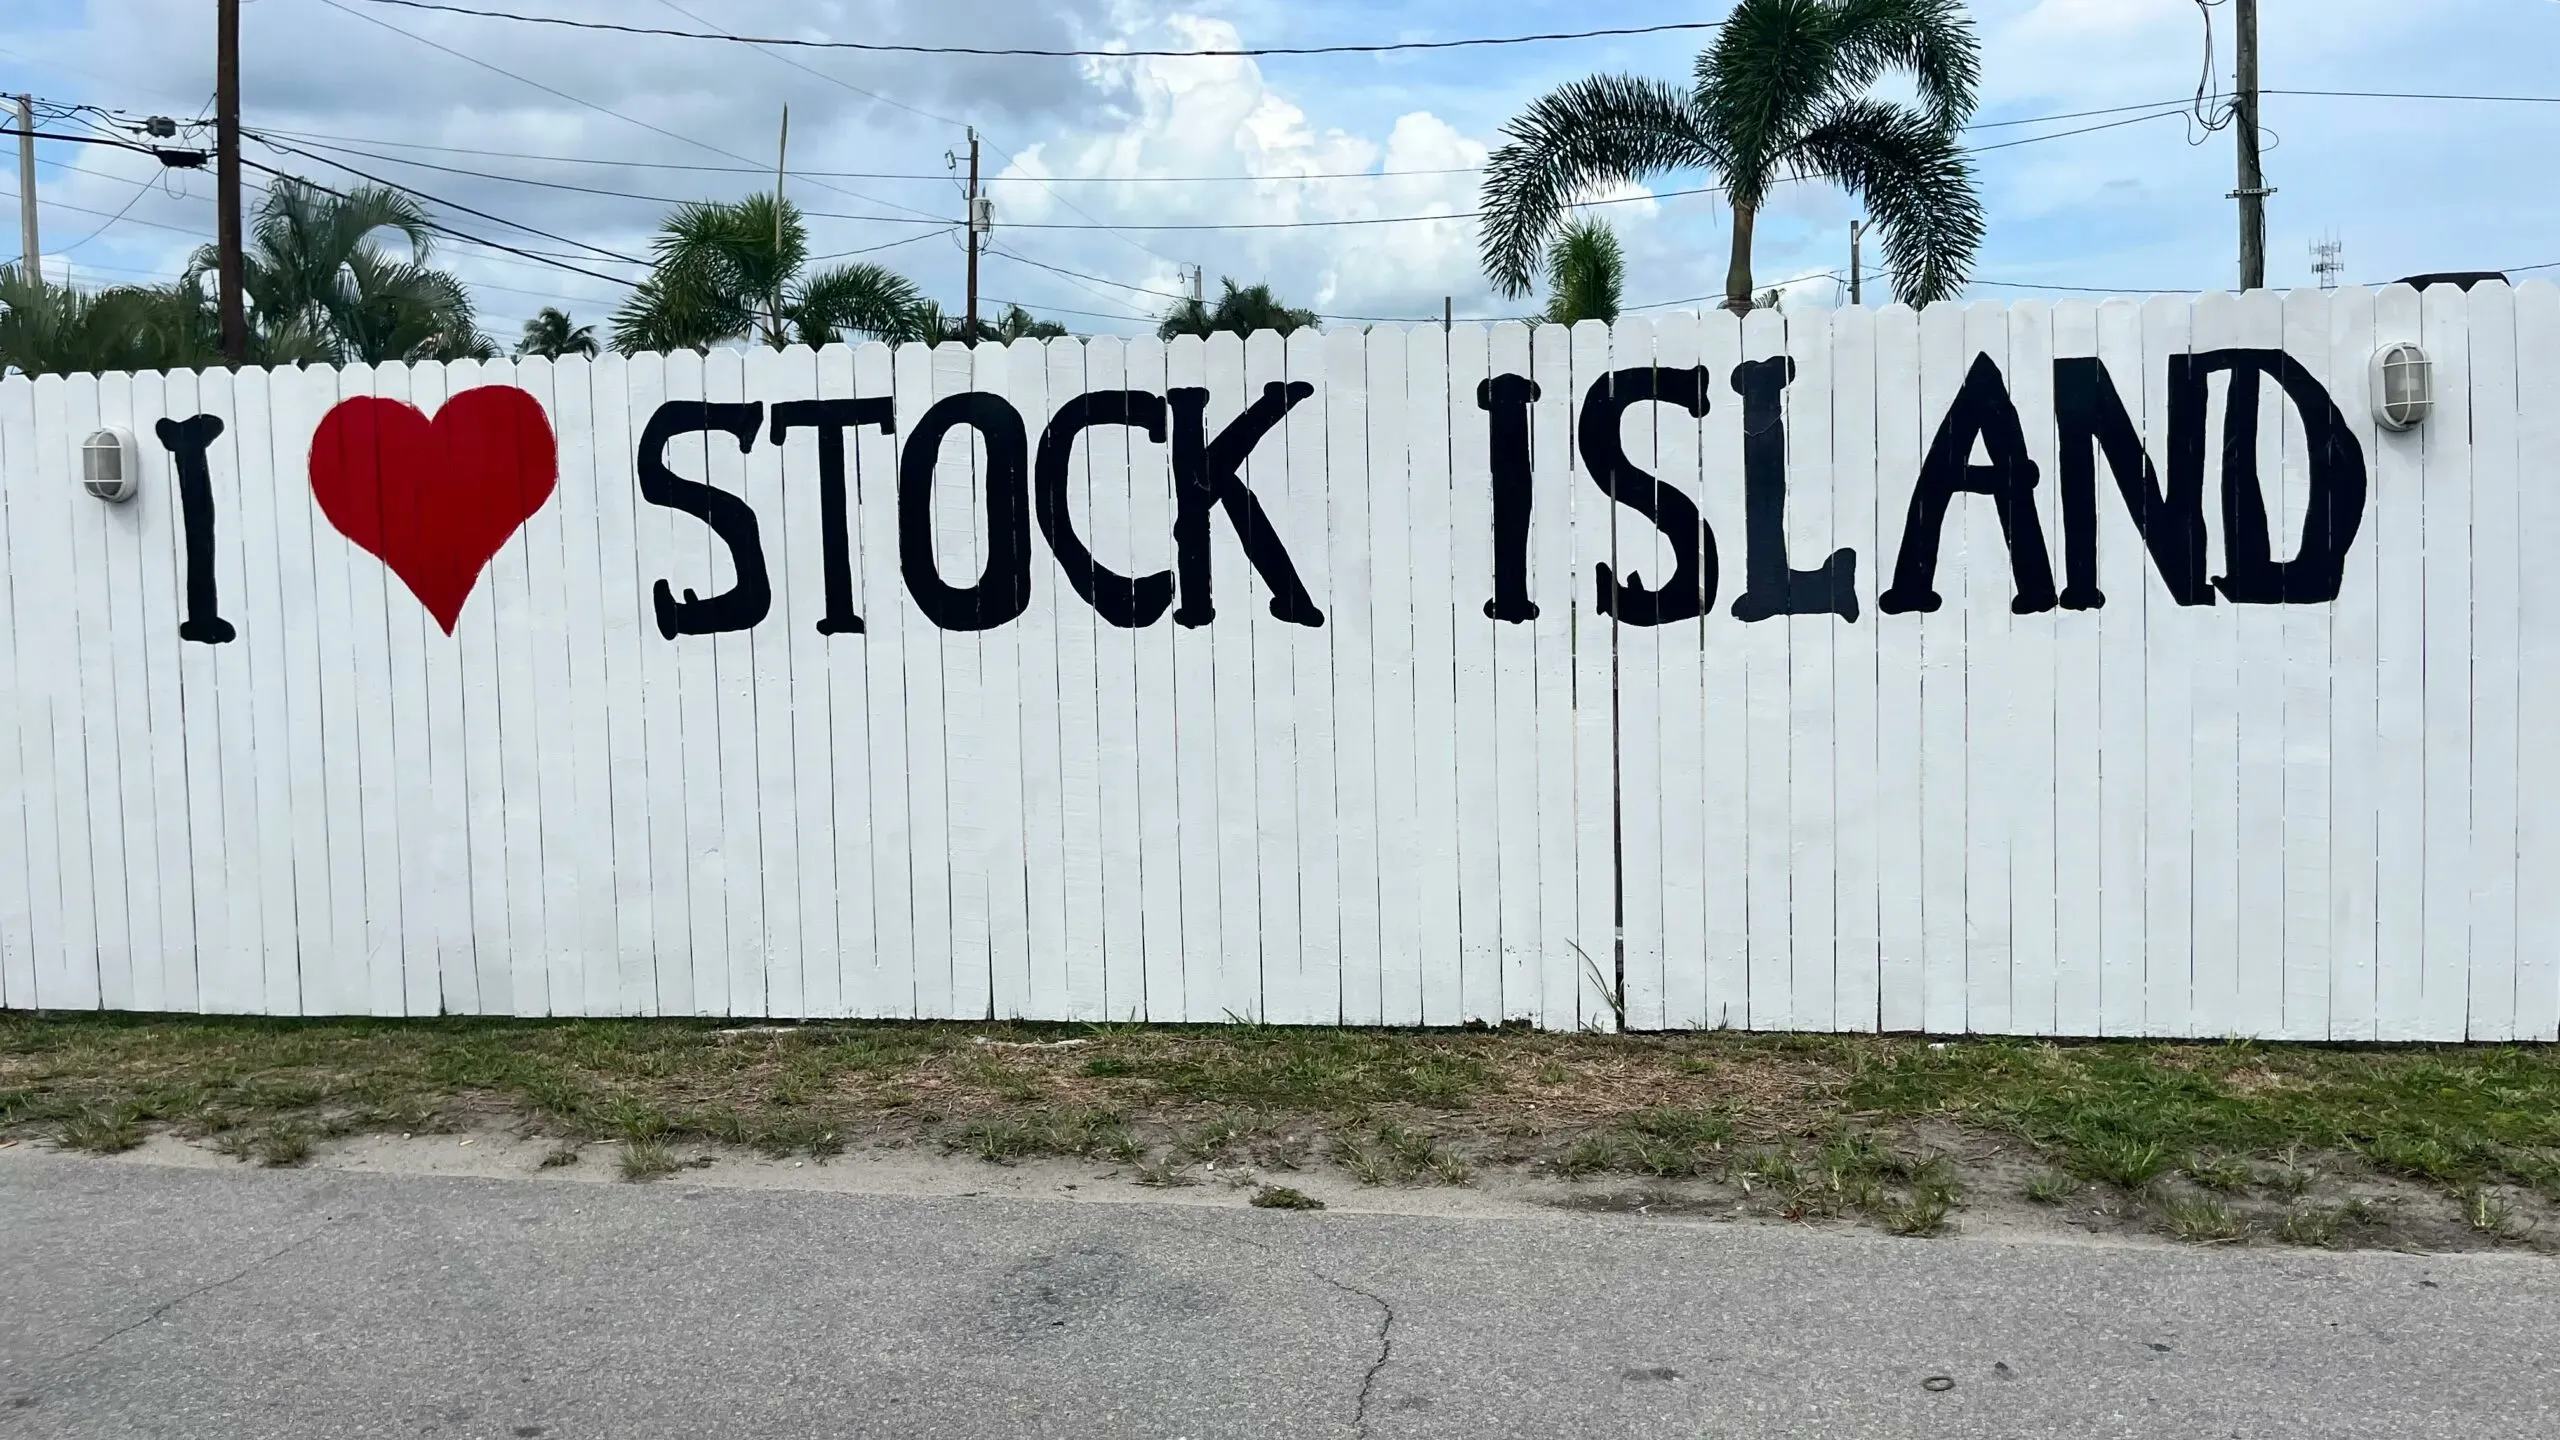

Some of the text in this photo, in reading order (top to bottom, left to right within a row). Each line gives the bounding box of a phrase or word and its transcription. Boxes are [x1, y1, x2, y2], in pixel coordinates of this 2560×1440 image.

[155, 348, 2367, 645] I STOCK ISLAND
